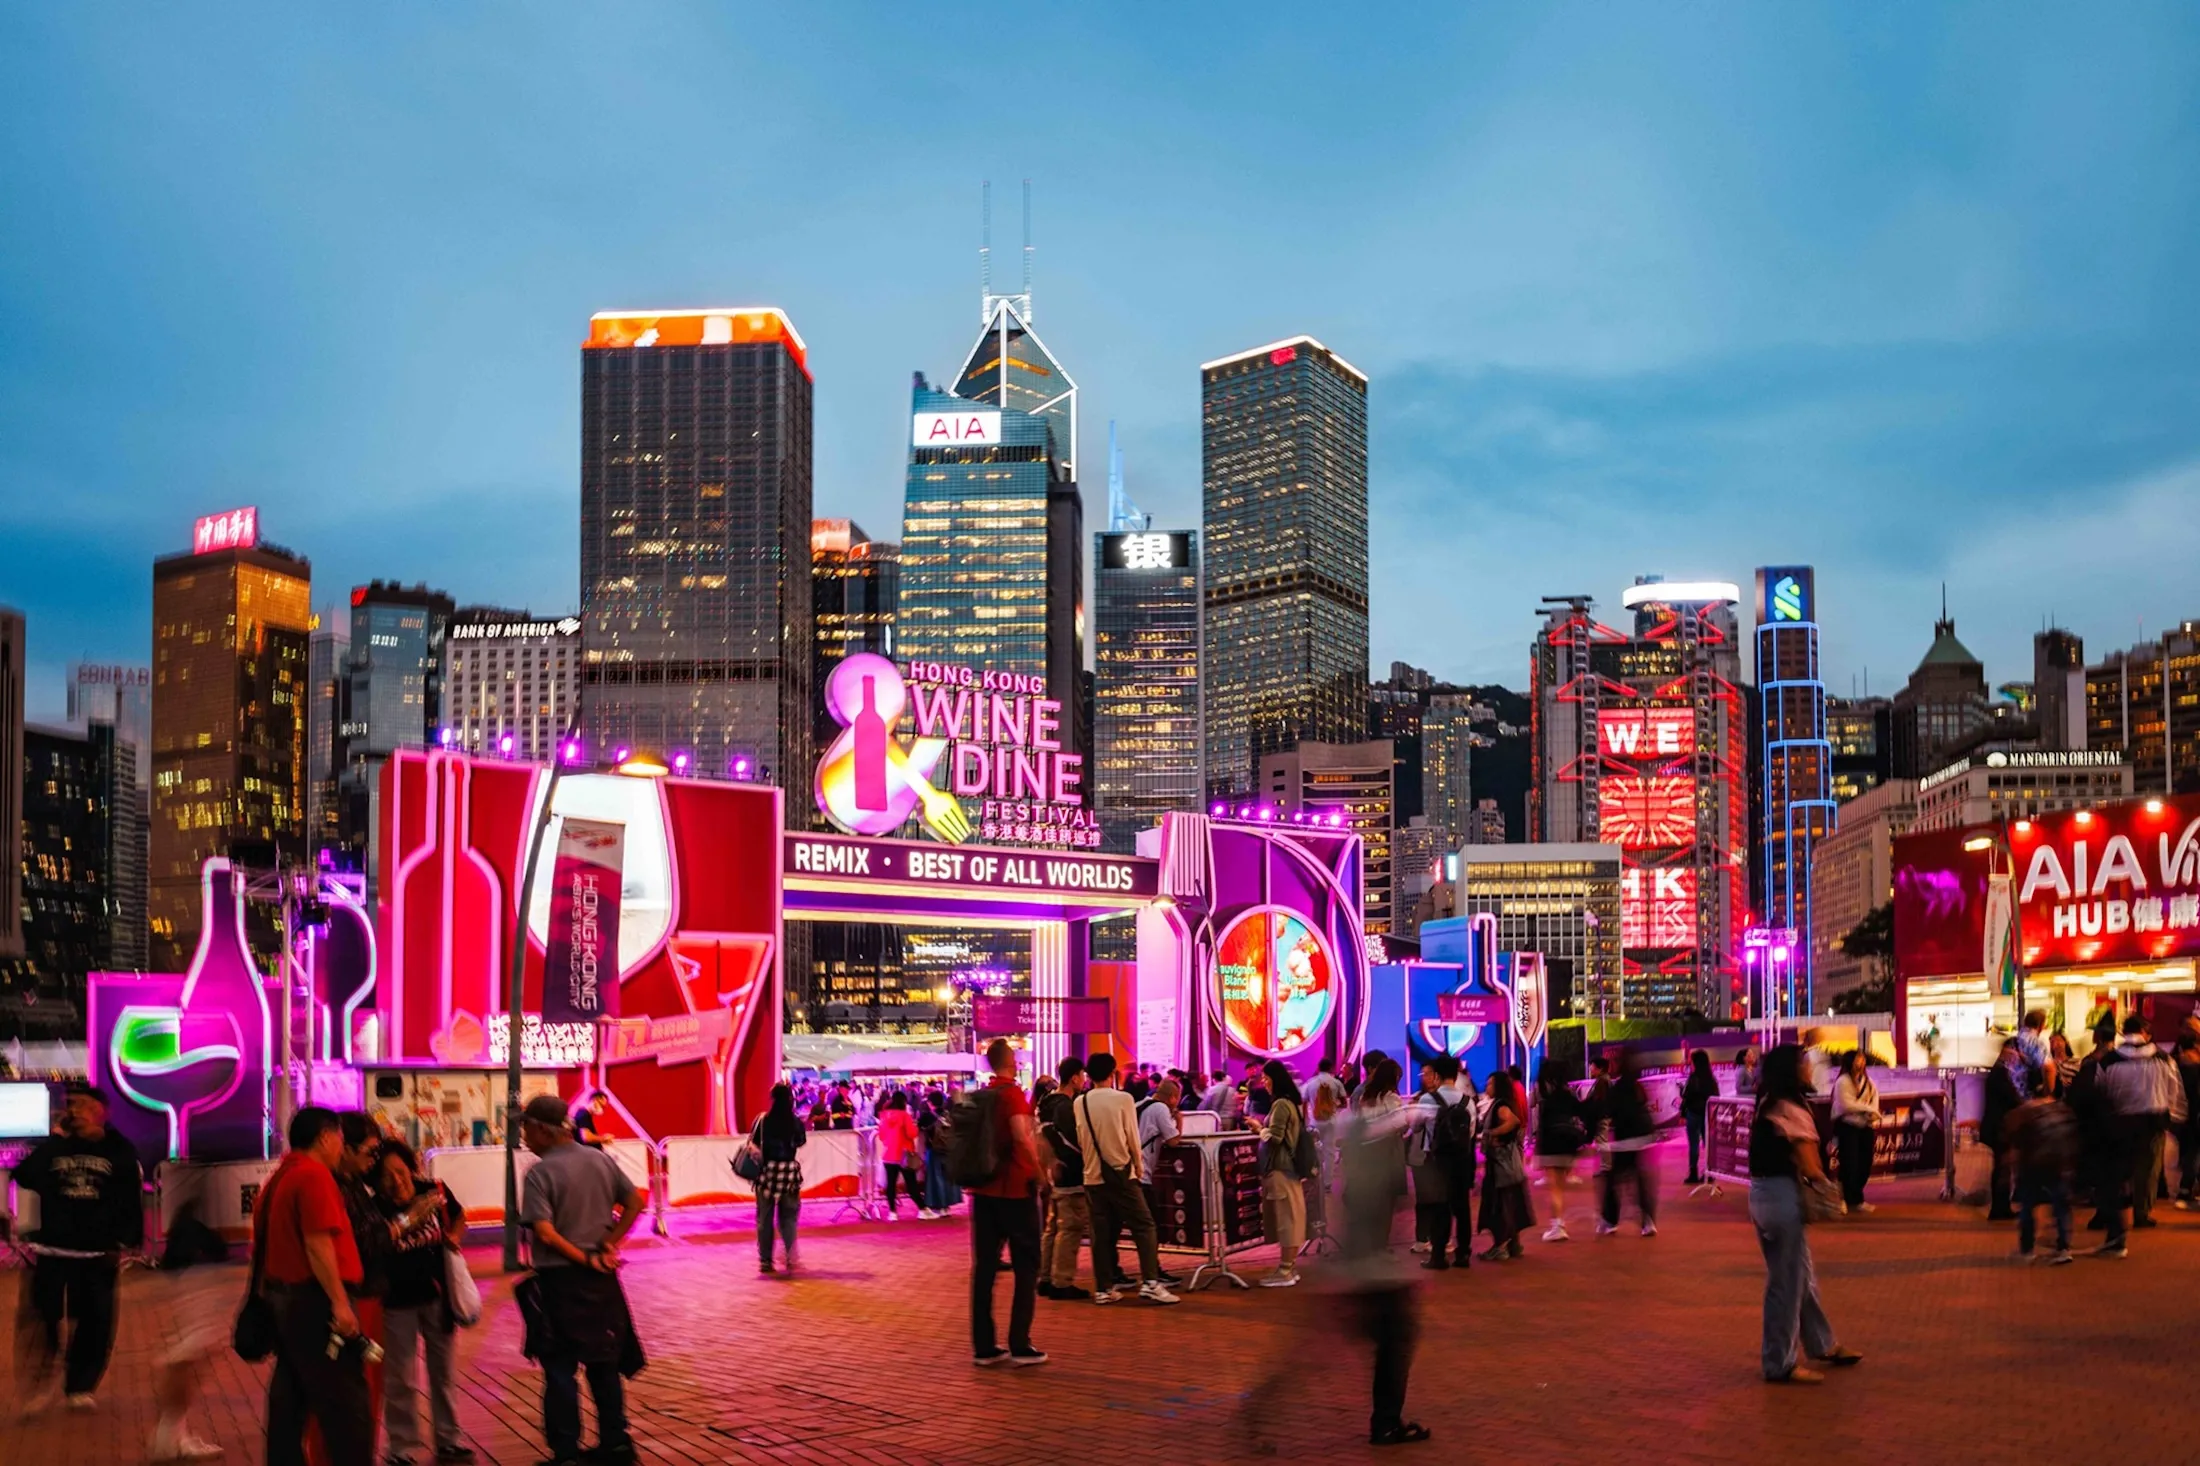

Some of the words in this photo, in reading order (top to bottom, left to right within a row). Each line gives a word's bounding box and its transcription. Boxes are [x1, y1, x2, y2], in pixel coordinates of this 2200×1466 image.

[929, 417, 986, 440] AIA
[453, 625, 485, 638] BANK
[487, 624, 502, 637] OF
[503, 623, 555, 637] AMERICA
[911, 661, 973, 686] HONG
[983, 670, 1043, 694] KONG
[910, 685, 1061, 750] WINE
[1605, 723, 1679, 753] WE
[953, 743, 1082, 805] DINE
[2009, 752, 2067, 767] MANDARIN
[2069, 751, 2121, 766] ORIENTAL
[983, 801, 1099, 828] FESTIVAL
[795, 843, 870, 874] REMIX
[909, 852, 964, 880] BEST
[970, 856, 998, 882] OF
[1003, 859, 1043, 886] ALL
[1047, 862, 1133, 890] WORLDS
[2020, 835, 2147, 904] AIA
[2159, 817, 2200, 888] Vi
[582, 873, 599, 940] HONG
[2054, 900, 2129, 938] HUB
[580, 941, 598, 1012] KONG
[1214, 963, 1257, 977] auvignon
